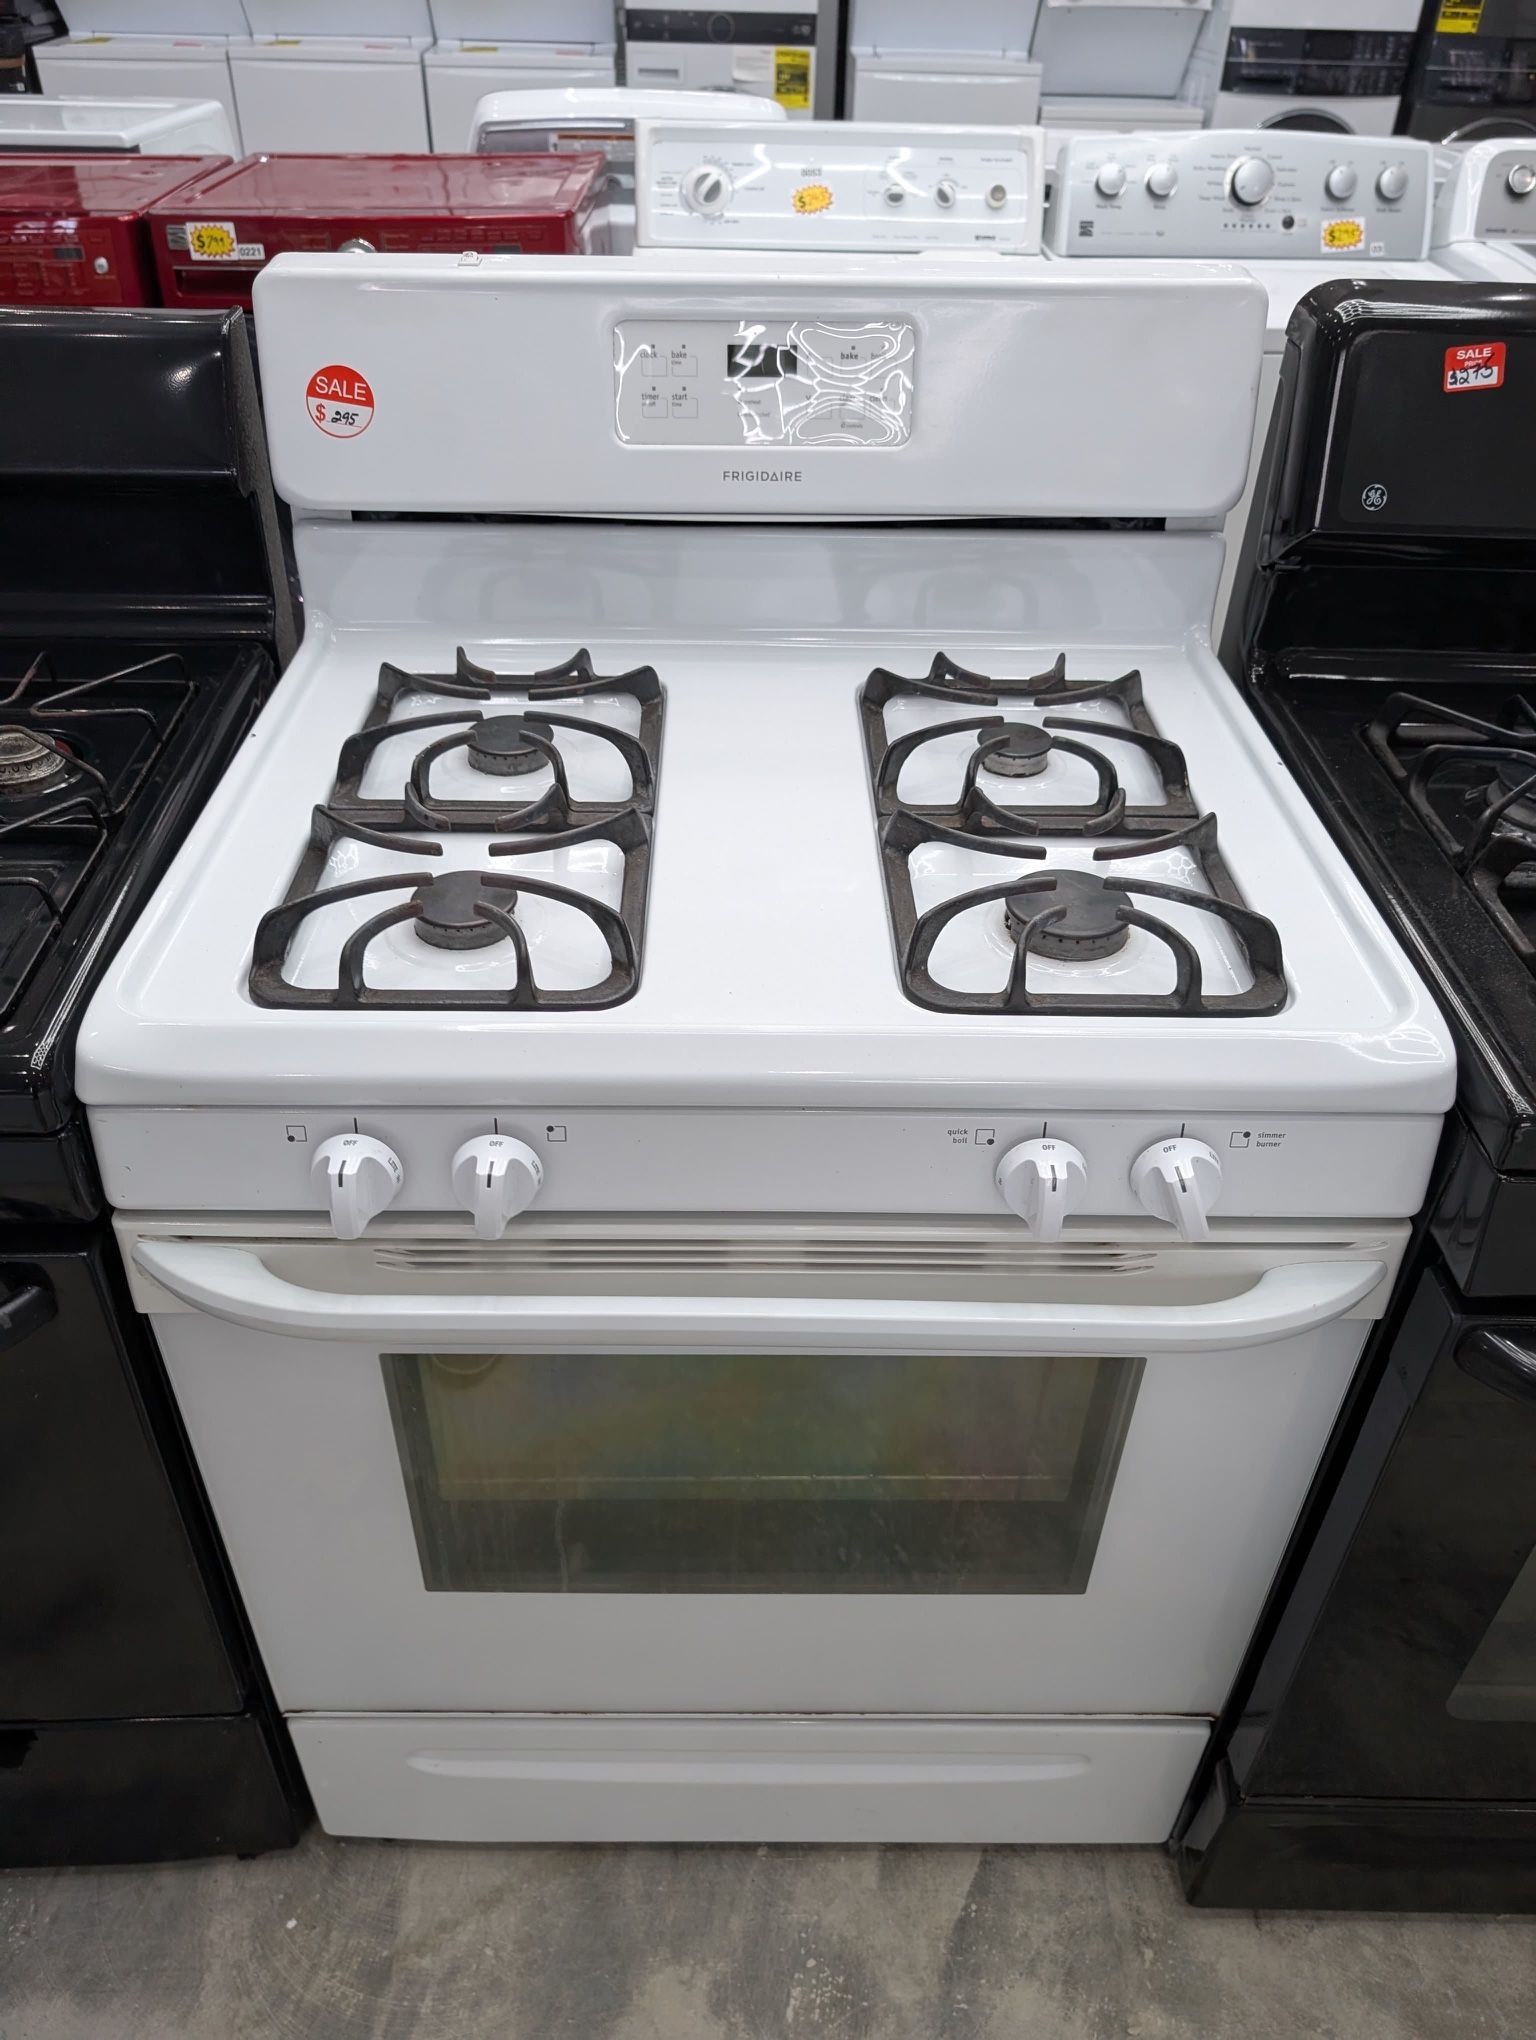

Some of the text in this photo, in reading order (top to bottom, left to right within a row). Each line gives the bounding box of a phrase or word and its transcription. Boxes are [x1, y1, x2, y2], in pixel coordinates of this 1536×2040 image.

[239, 247, 262, 257] 0221
[671, 351, 688, 359] bake
[840, 352, 858, 360] bake
[1456, 347, 1492, 360] SALE
[315, 376, 367, 402] SALE
[641, 393, 660, 401] timer
[671, 393, 688, 401] start
[722, 470, 803, 483] FRIGIDAIRE
[946, 1128, 968, 1136] quick
[1256, 1131, 1287, 1139] simmer
[342, 1139, 358, 1147] OFF
[488, 1140, 504, 1148] OFF
[1255, 1140, 1282, 1148] burner
[1162, 1144, 1177, 1153] OFF
